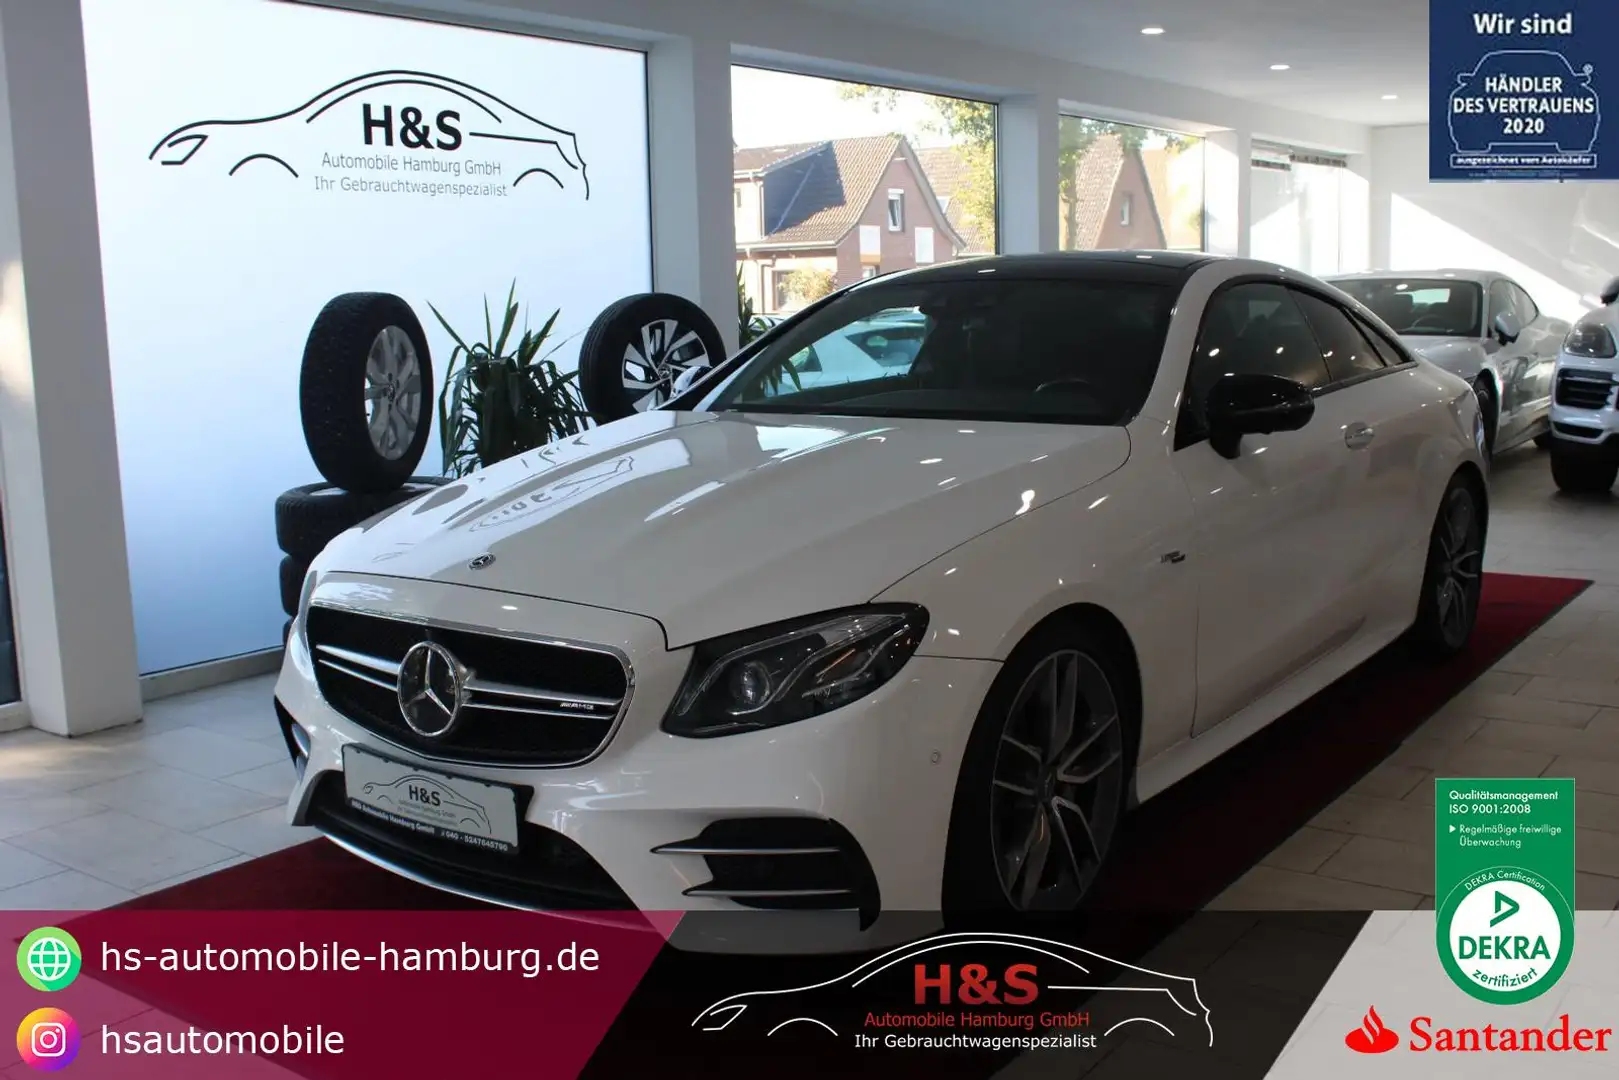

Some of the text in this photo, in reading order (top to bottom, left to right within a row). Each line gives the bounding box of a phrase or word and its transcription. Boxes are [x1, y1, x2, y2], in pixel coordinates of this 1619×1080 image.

[362, 102, 463, 150] H&S
[321, 152, 501, 176] Automobile Hamburg GmbH
[314, 175, 508, 198] Ihr Gebrauchtwagenspezialist
[408, 785, 441, 806] H&S
